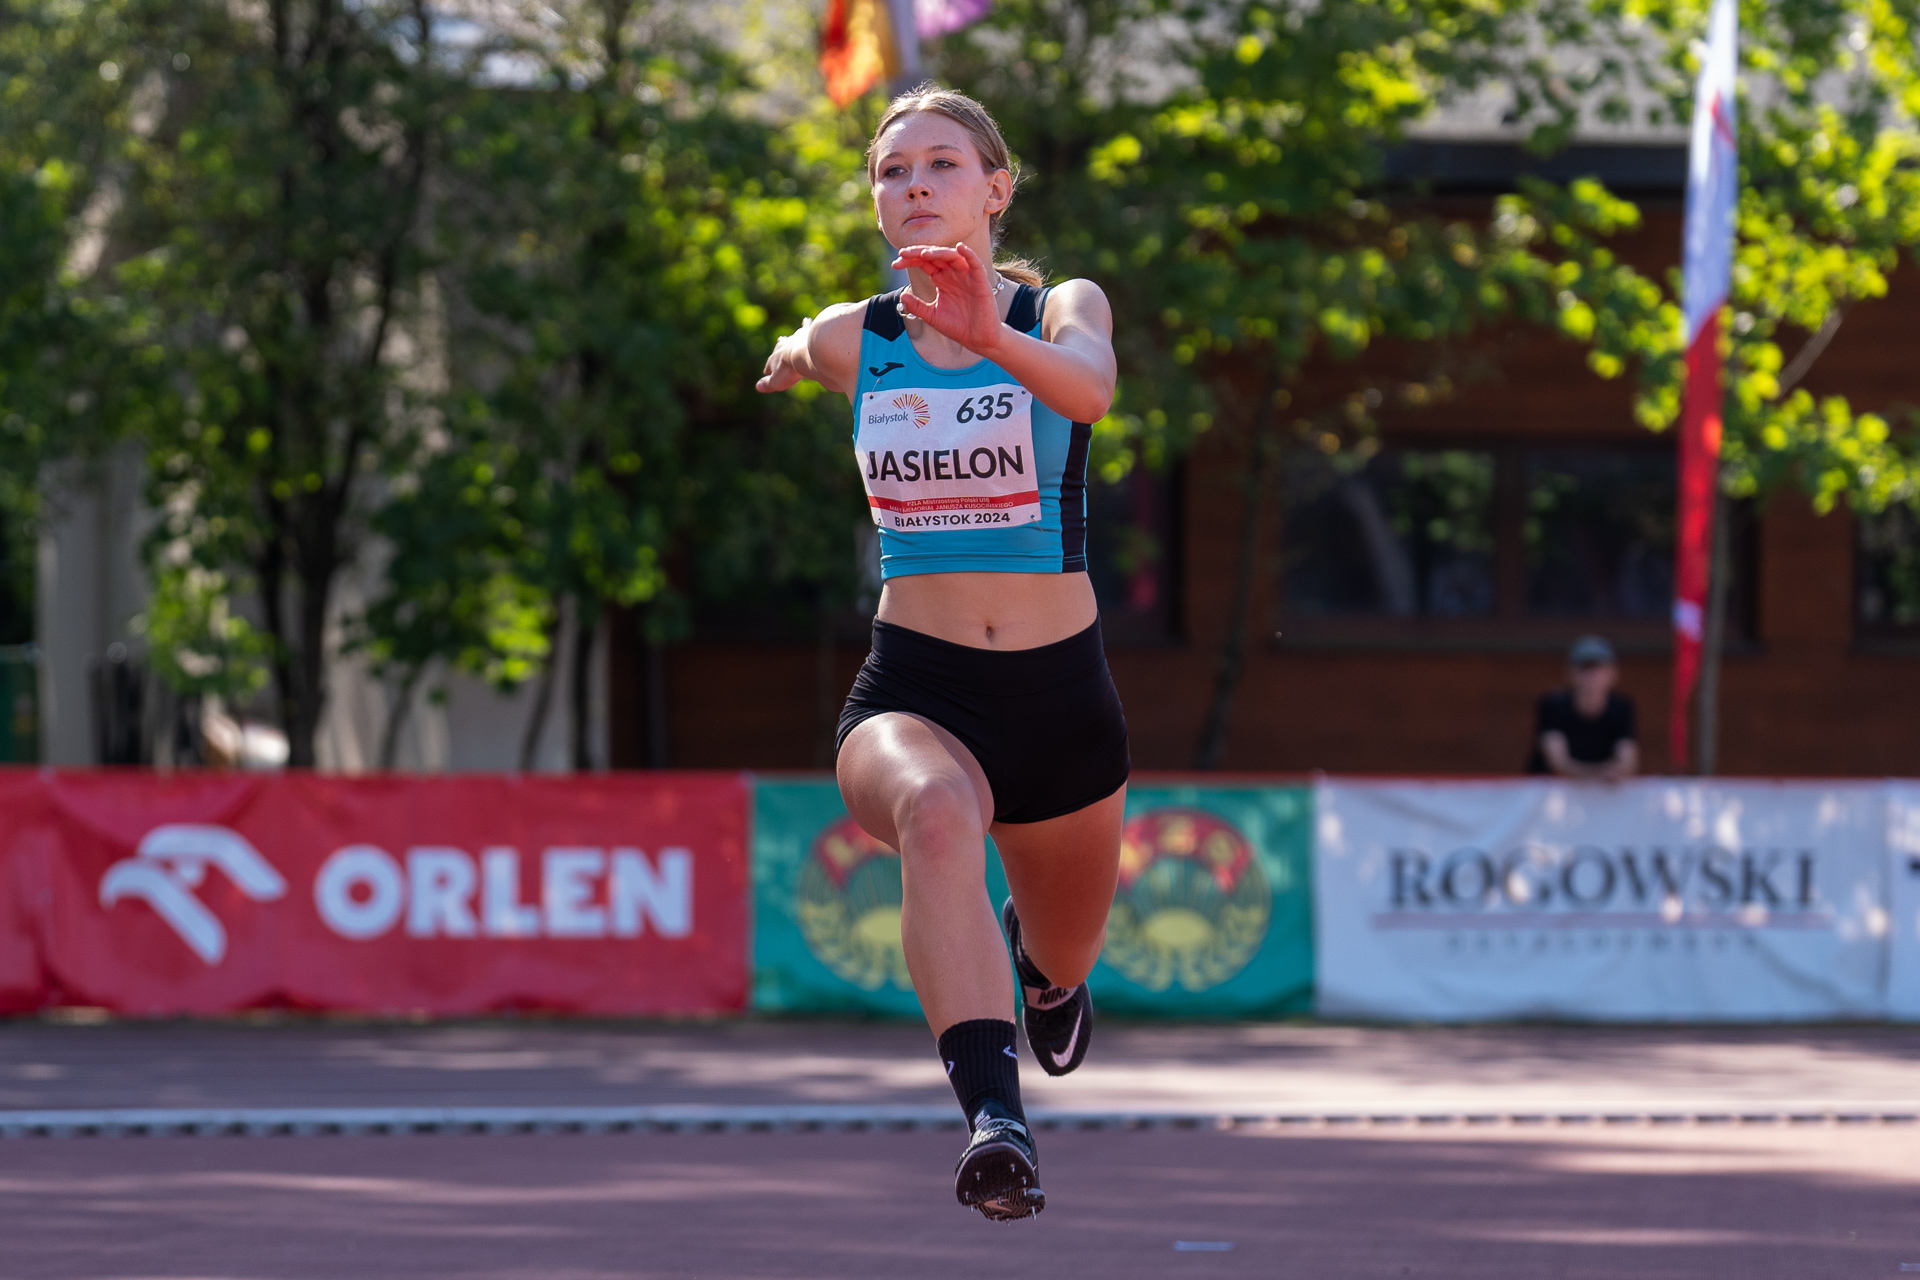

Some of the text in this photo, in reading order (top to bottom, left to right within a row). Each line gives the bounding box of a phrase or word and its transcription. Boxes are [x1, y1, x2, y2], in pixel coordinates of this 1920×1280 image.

[868, 411, 909, 425] Białystok
[956, 392, 1014, 424] 635
[868, 445, 1025, 482] JASIELON
[894, 512, 1011, 527] BIAŁYSTOK 2024
[314, 843, 694, 940] ORLEN
[1387, 845, 1819, 911] ROGOWSKI
